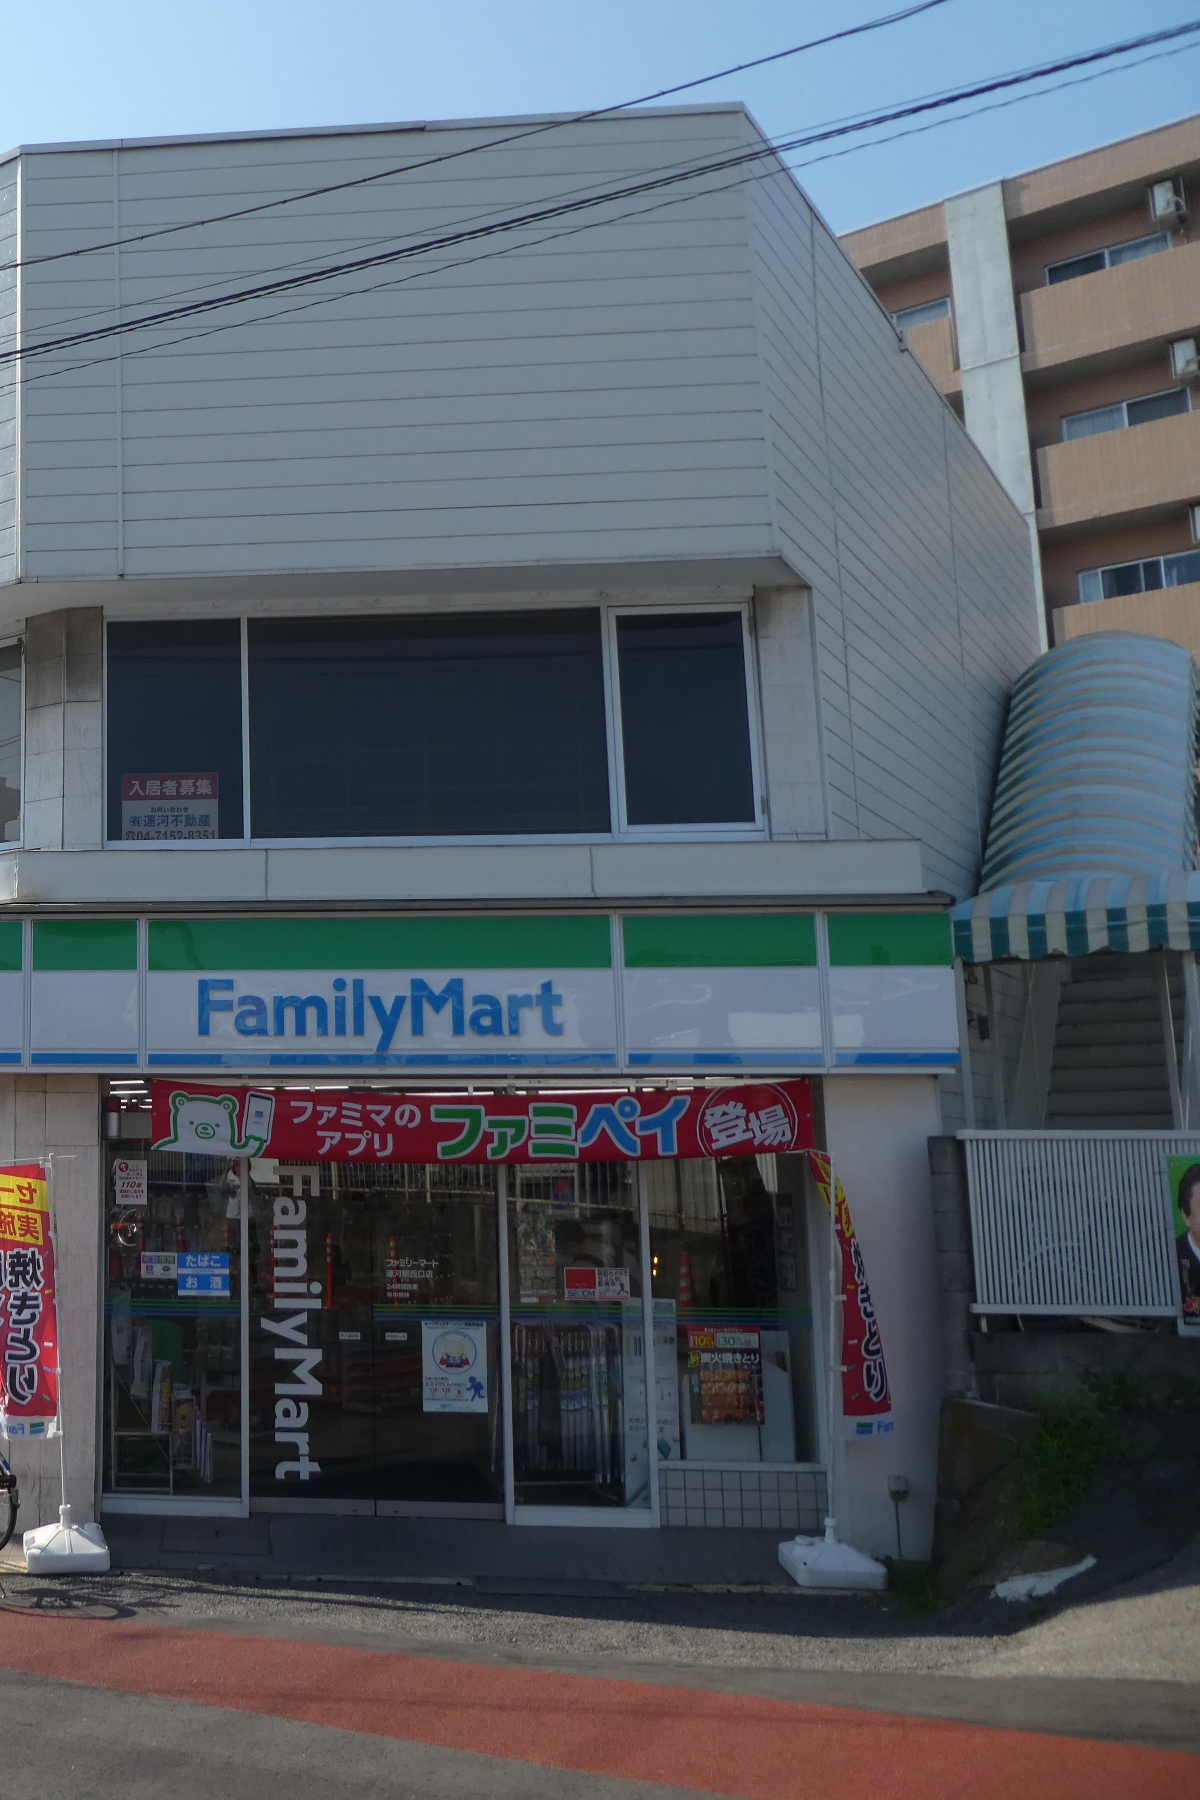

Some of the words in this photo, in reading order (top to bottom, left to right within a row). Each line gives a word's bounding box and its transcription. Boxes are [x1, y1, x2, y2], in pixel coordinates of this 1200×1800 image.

[128, 779, 212, 796] 入居者募集
[197, 977, 563, 1053] FamilyMart
[289, 1100, 422, 1129] ファミマの
[429, 1095, 692, 1160] ファミペイ
[702, 1100, 793, 1150] 登場
[316, 1129, 394, 1157] アプリ
[185, 1254, 221, 1267] たばこ
[385, 1257, 439, 1268] ファミリーマート
[386, 1269, 433, 1278] 運河駅西口店
[260, 1166, 323, 1481] FamilyMart
[700, 1352, 760, 1364] 炭火焼きとり
